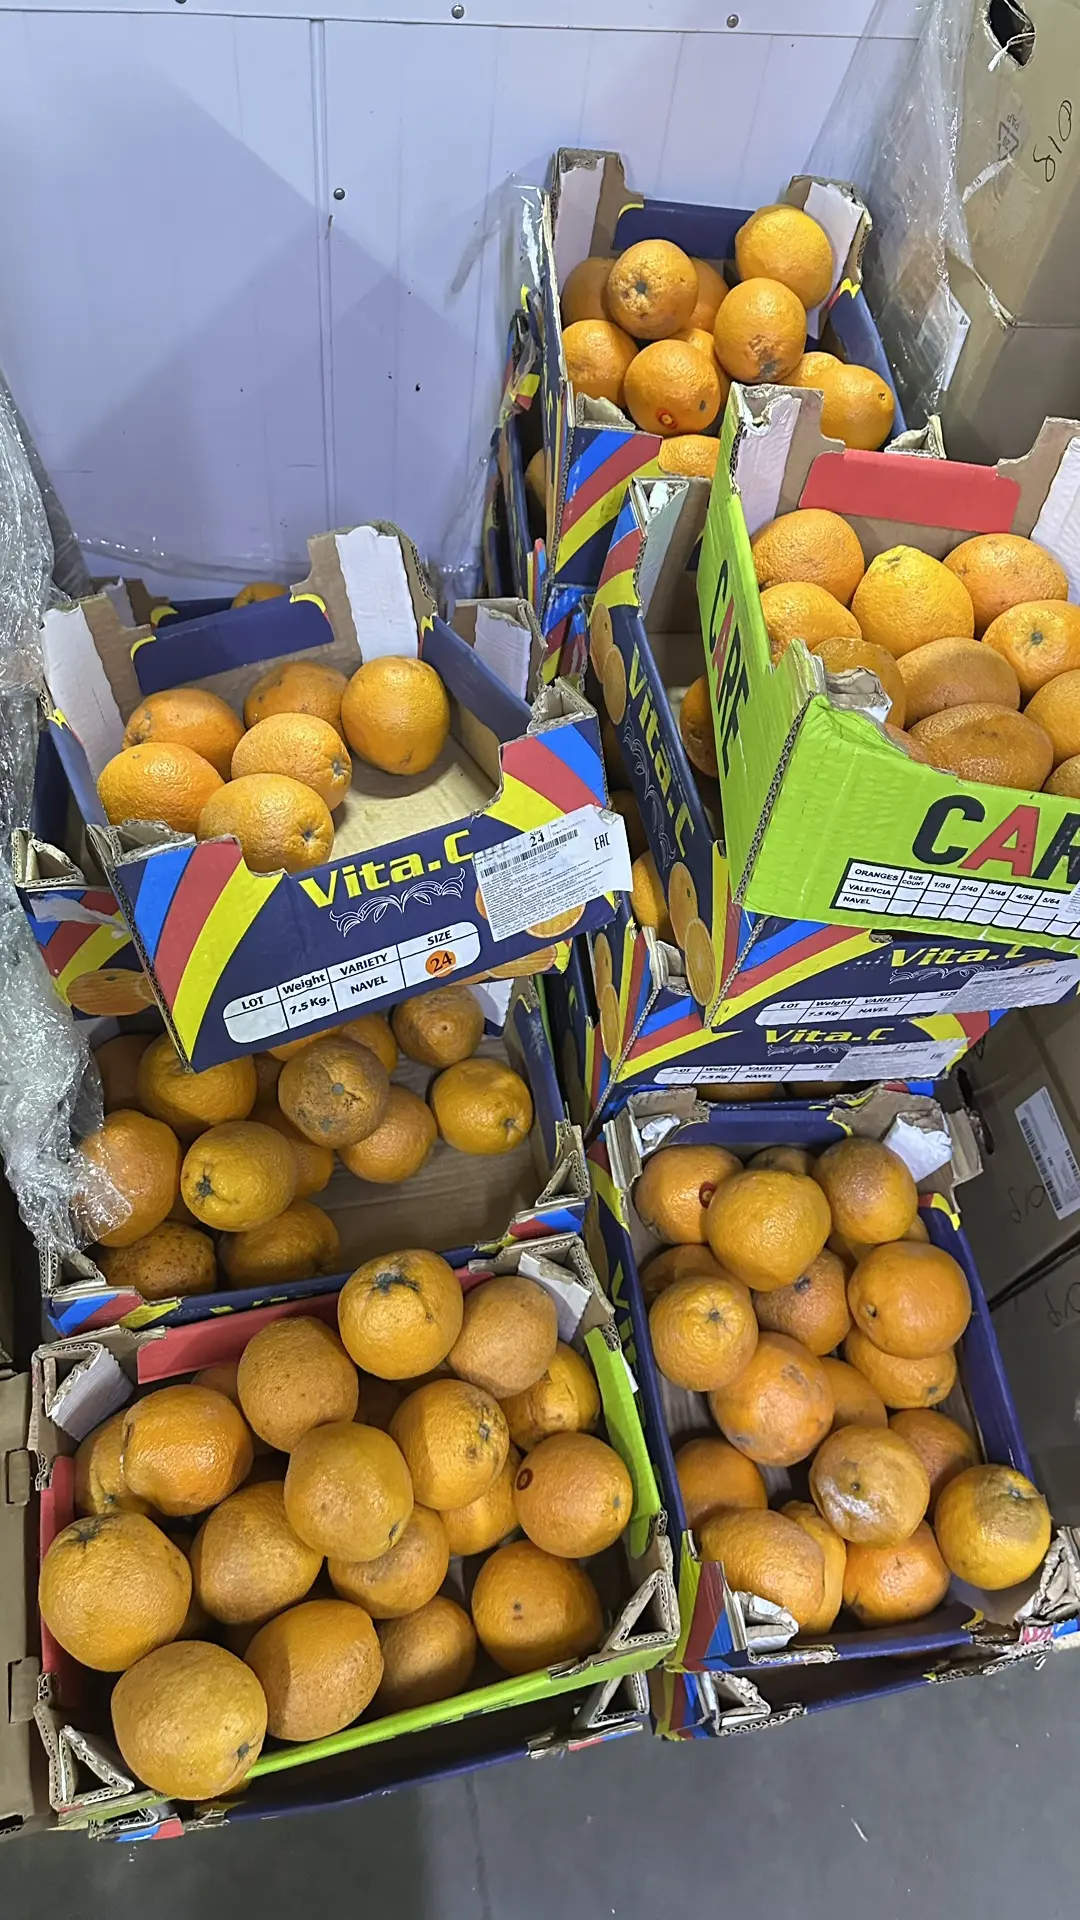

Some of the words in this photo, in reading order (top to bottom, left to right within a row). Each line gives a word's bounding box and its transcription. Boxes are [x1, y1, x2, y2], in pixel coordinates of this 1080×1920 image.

[708, 559, 750, 779] CARE
[628, 642, 696, 858] Vita.C
[529, 832, 546, 848] 24
[593, 832, 612, 851] EAC
[298, 829, 475, 908] Vita.C
[854, 868, 899, 882] ORANGES
[848, 883, 892, 896] VALENCIA
[902, 879, 925, 887] COUNT
[842, 895, 871, 905] NAVEL
[241, 995, 264, 1010] LOT
[282, 973, 326, 994] Weight
[340, 952, 388, 976] VARIETY
[427, 930, 452, 946] SIZE
[289, 1002, 309, 1015] 7.5
[310, 996, 331, 1007] Kg.
[350, 976, 388, 994] NAVEL
[430, 952, 453, 972] 24
[815, 999, 852, 1007] Weight
[765, 1027, 896, 1043] Vita.C
